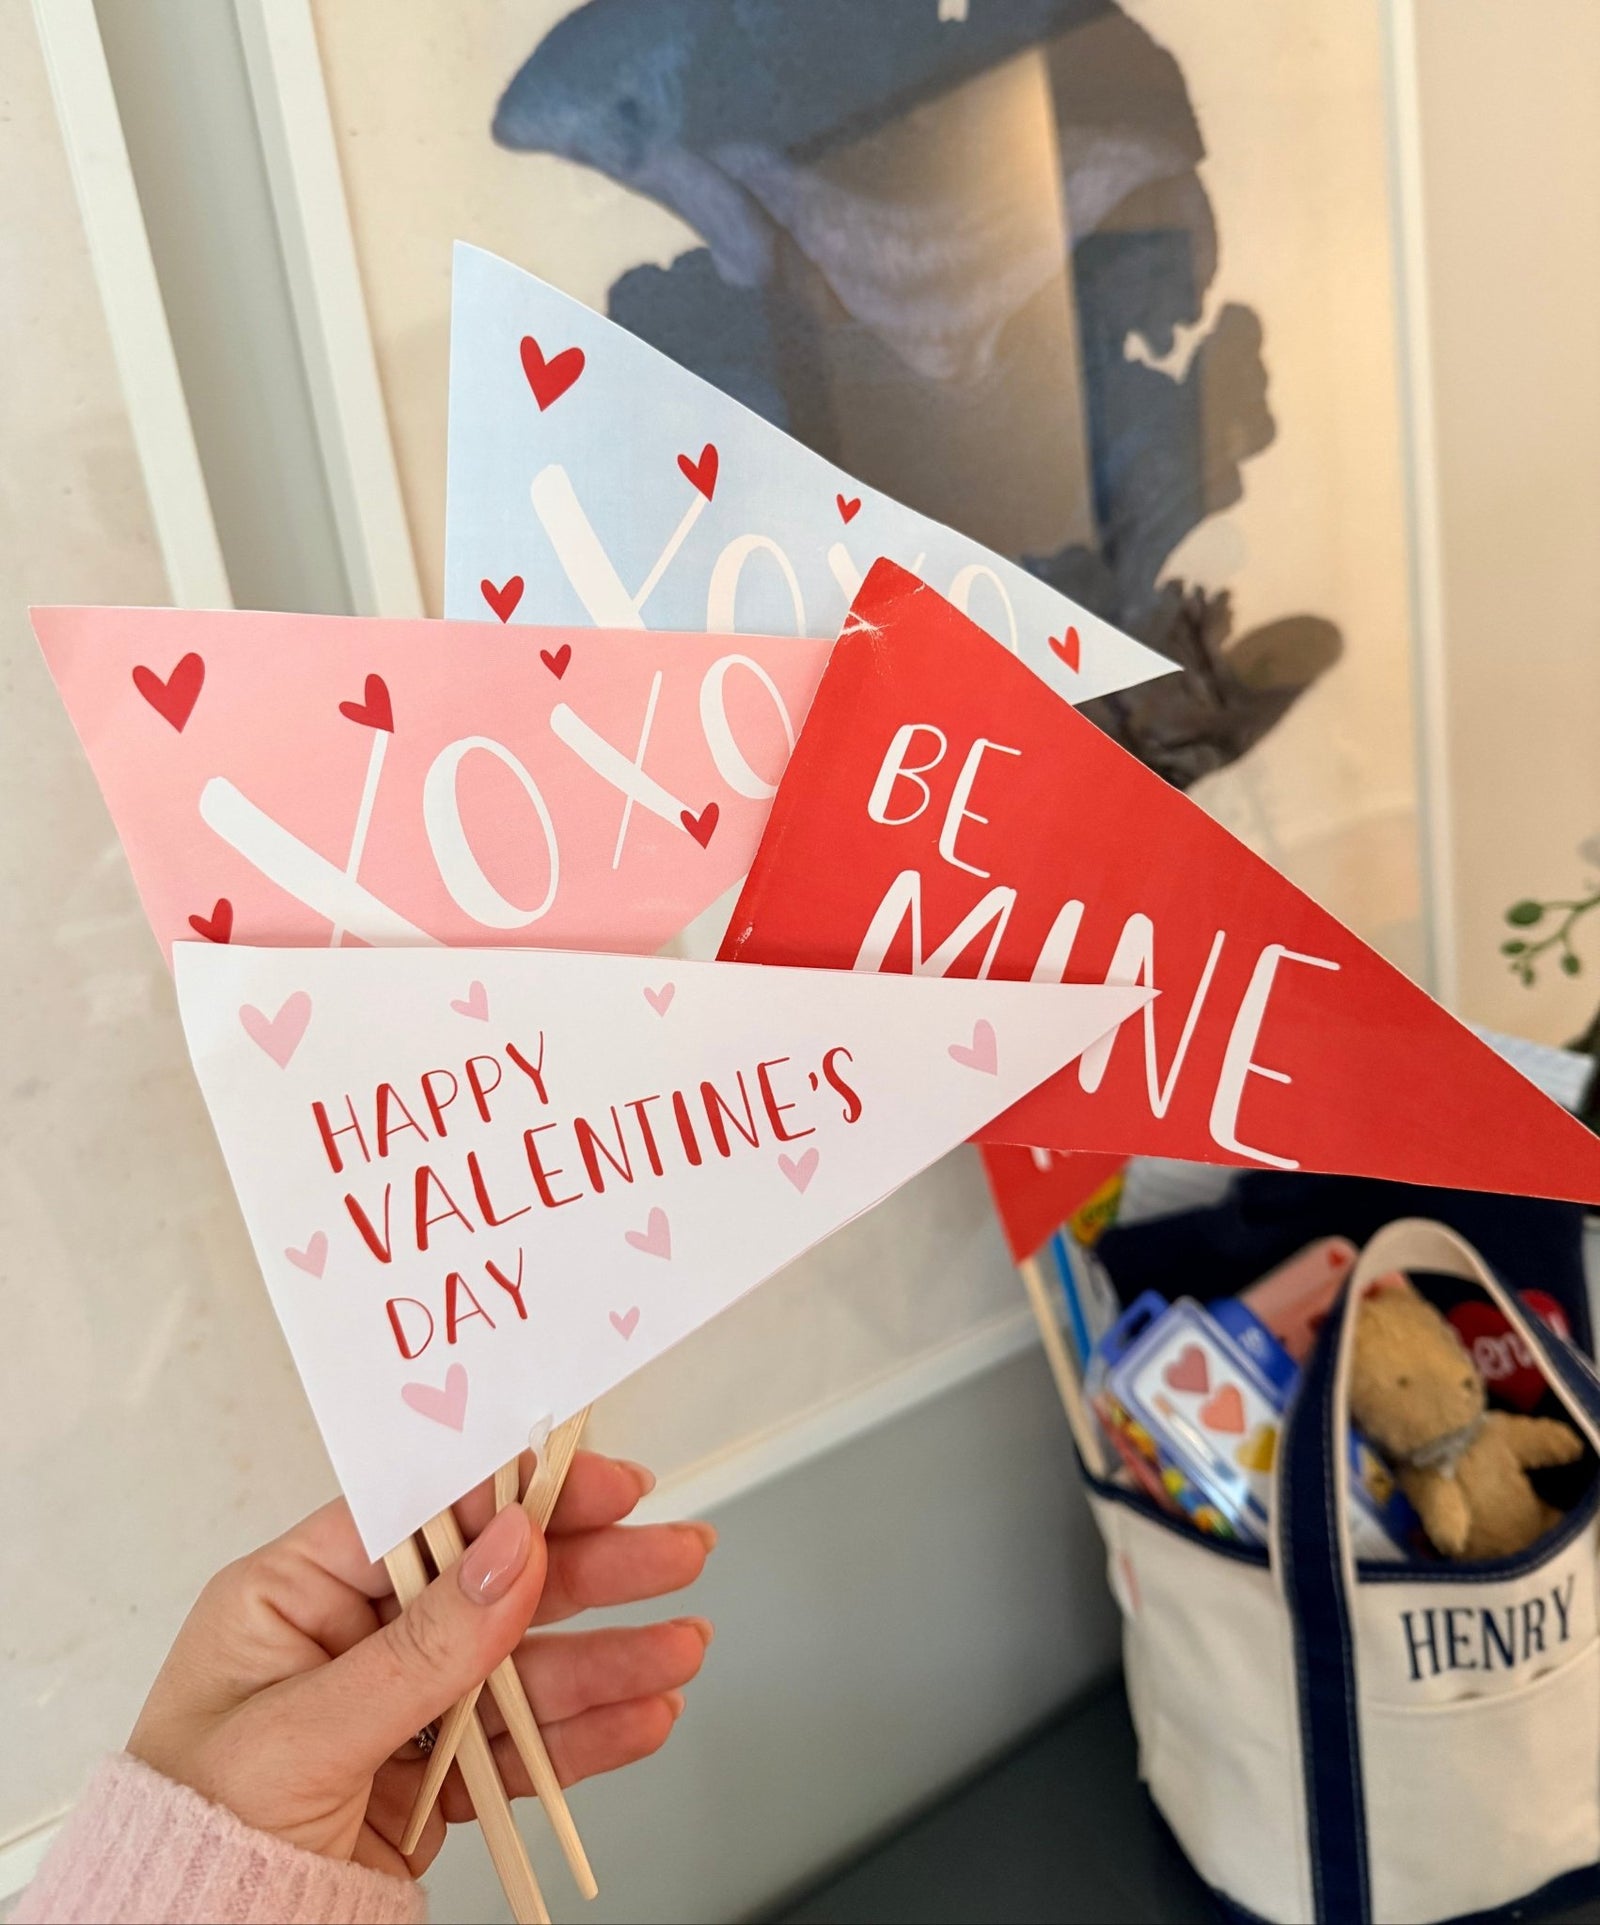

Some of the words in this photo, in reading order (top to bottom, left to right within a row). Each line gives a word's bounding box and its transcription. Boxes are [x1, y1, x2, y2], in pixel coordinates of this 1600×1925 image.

[200, 654, 796, 948] XOXO
[867, 723, 1021, 878] BE
[311, 1031, 549, 1173] HAPPY
[344, 1046, 863, 1264] VALENTINE'S
[385, 1247, 529, 1359] DAY
[1401, 1574, 1575, 1681] HENRY
